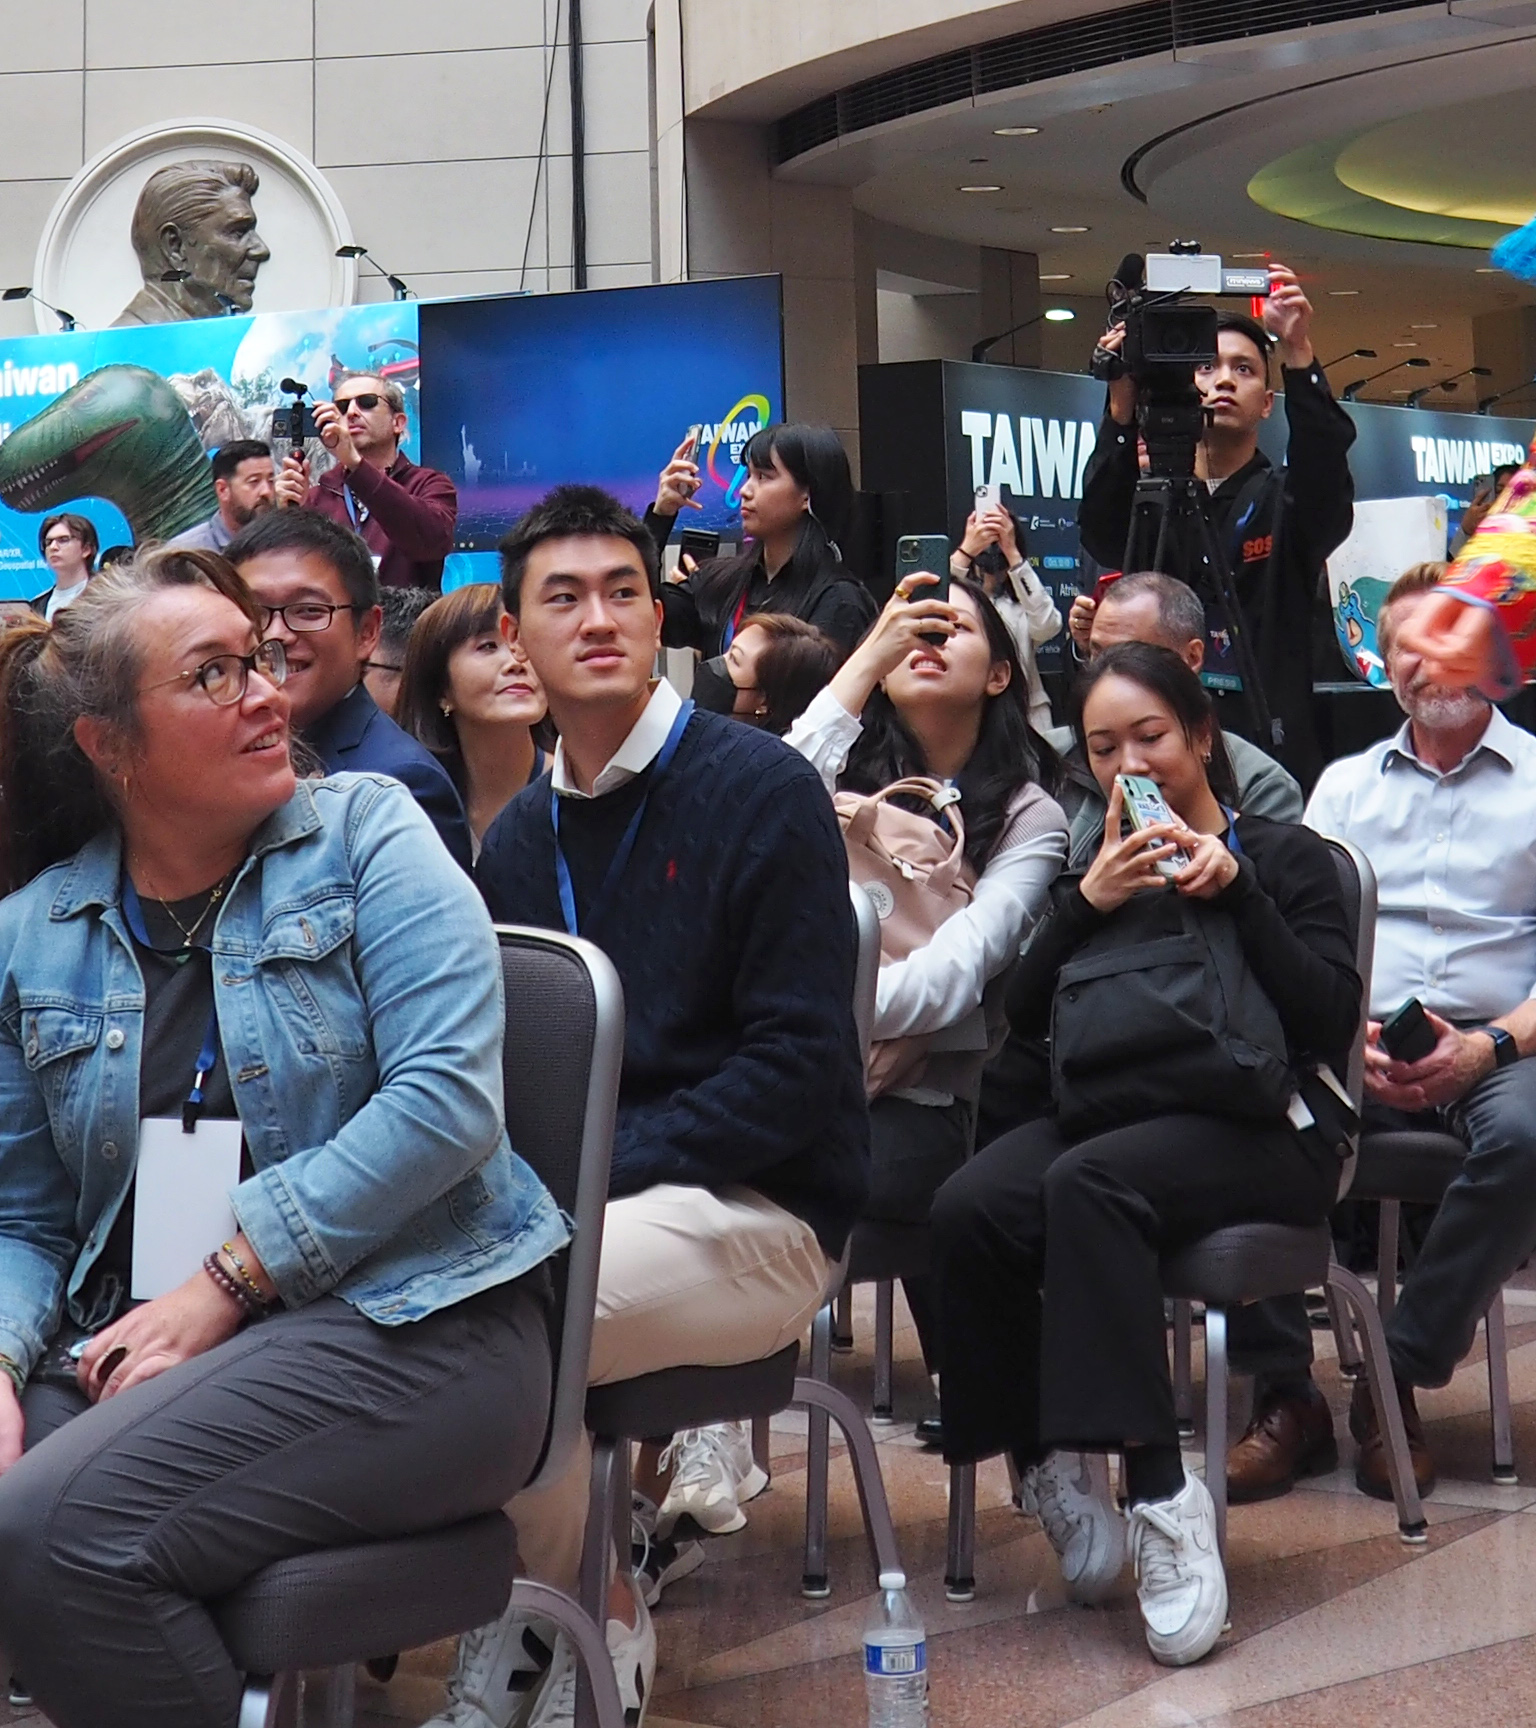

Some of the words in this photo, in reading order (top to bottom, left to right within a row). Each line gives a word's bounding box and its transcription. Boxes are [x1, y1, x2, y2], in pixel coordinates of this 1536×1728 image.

[1411, 436, 1490, 485] TAIWAN
[1491, 442, 1525, 466] EXPO
[1208, 677, 1237, 688] PRESS
